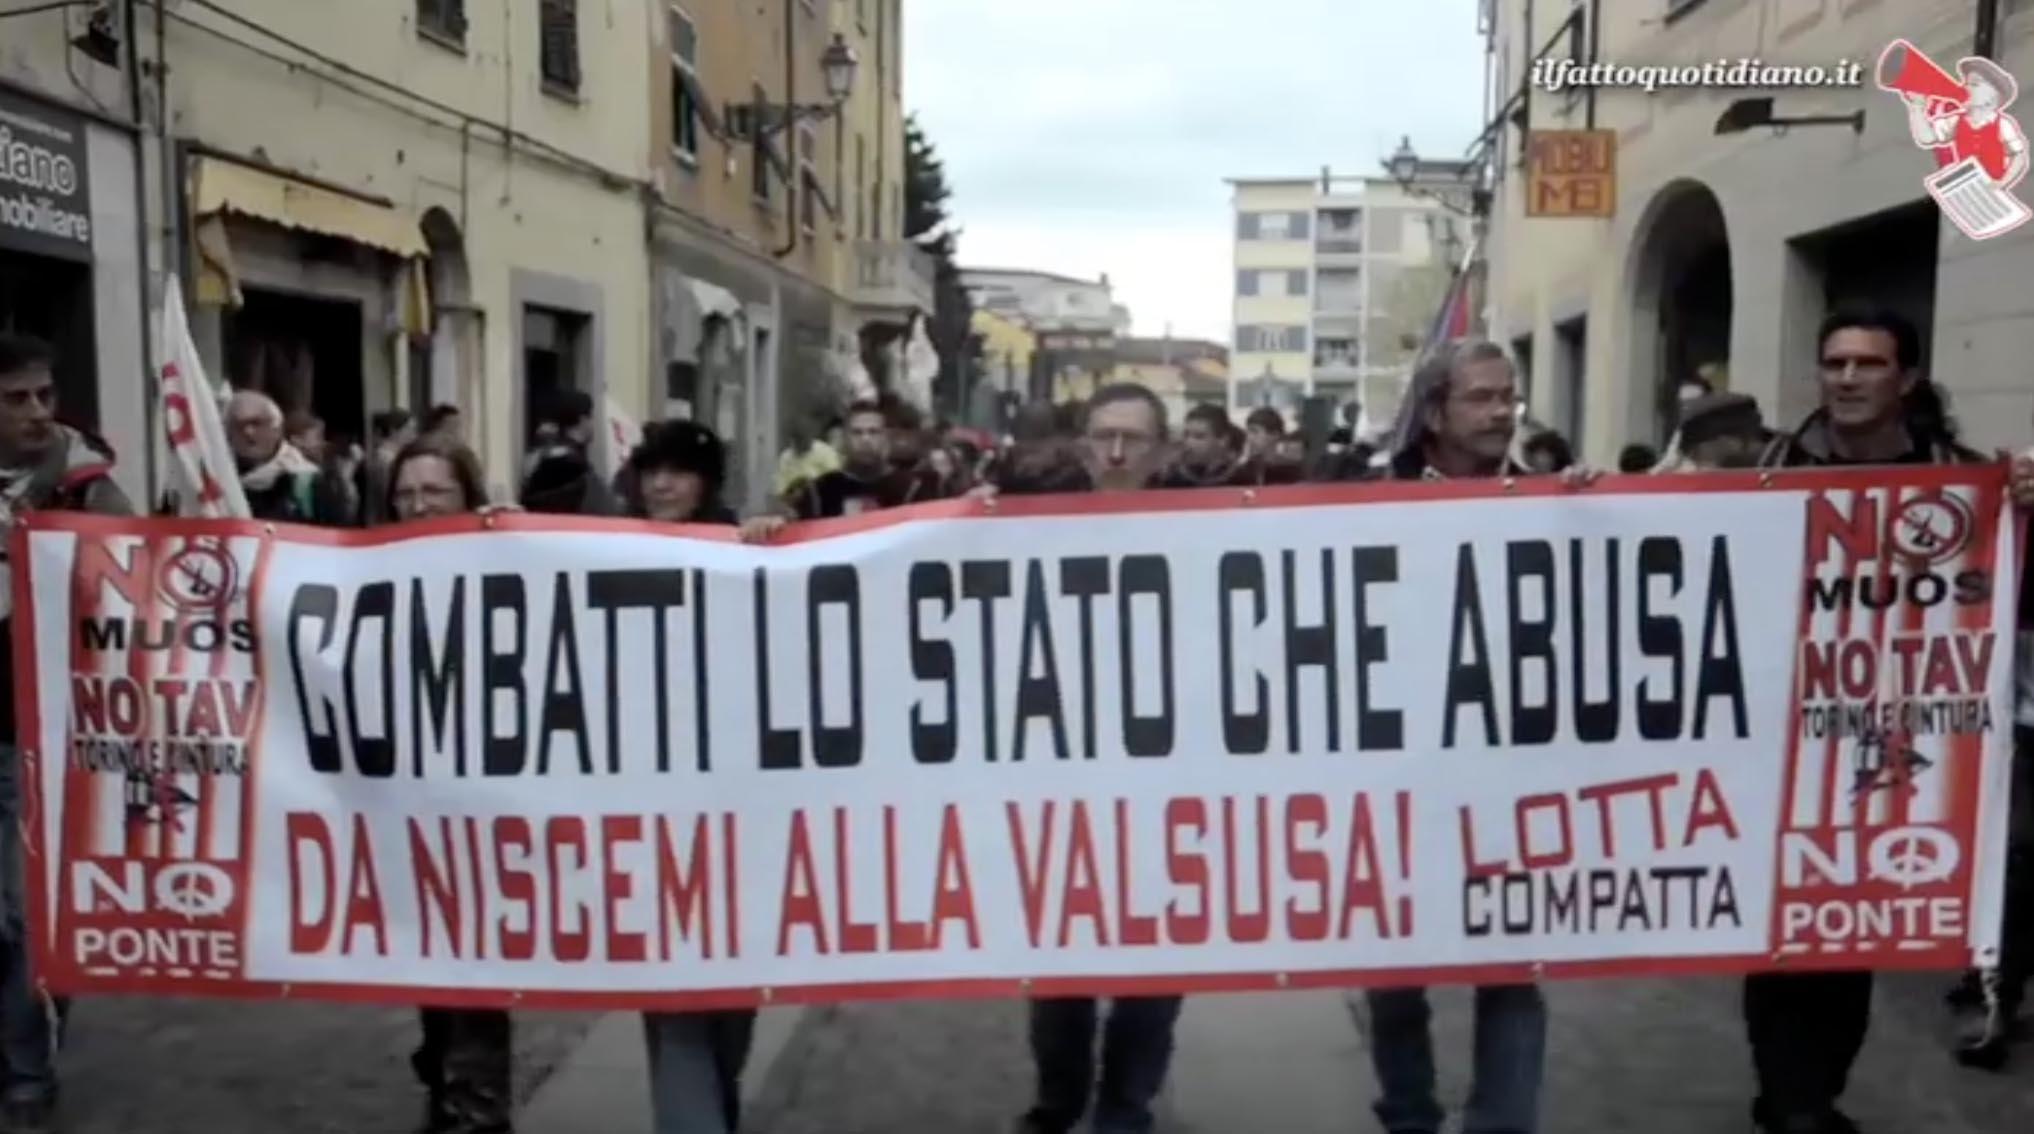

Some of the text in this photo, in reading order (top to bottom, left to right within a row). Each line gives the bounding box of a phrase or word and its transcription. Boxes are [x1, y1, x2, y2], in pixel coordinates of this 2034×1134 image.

[1806, 569, 1992, 612] MUOS
[80, 617, 258, 653] MUOS
[287, 534, 1750, 778] COMBATTI LO STATO CHE ABUSA
[1801, 631, 1997, 700] NO TAV
[72, 675, 259, 738] NO TAV
[1458, 768, 1740, 877] LOTTA
[286, 789, 1413, 963] DA NISCEMI ALLA VALSUSA!
[1781, 827, 1961, 890] NO
[71, 861, 235, 921] NO
[1462, 865, 1742, 937] COMPATTA
[1783, 896, 1964, 942] PONTE
[74, 928, 239, 968] PONTE
